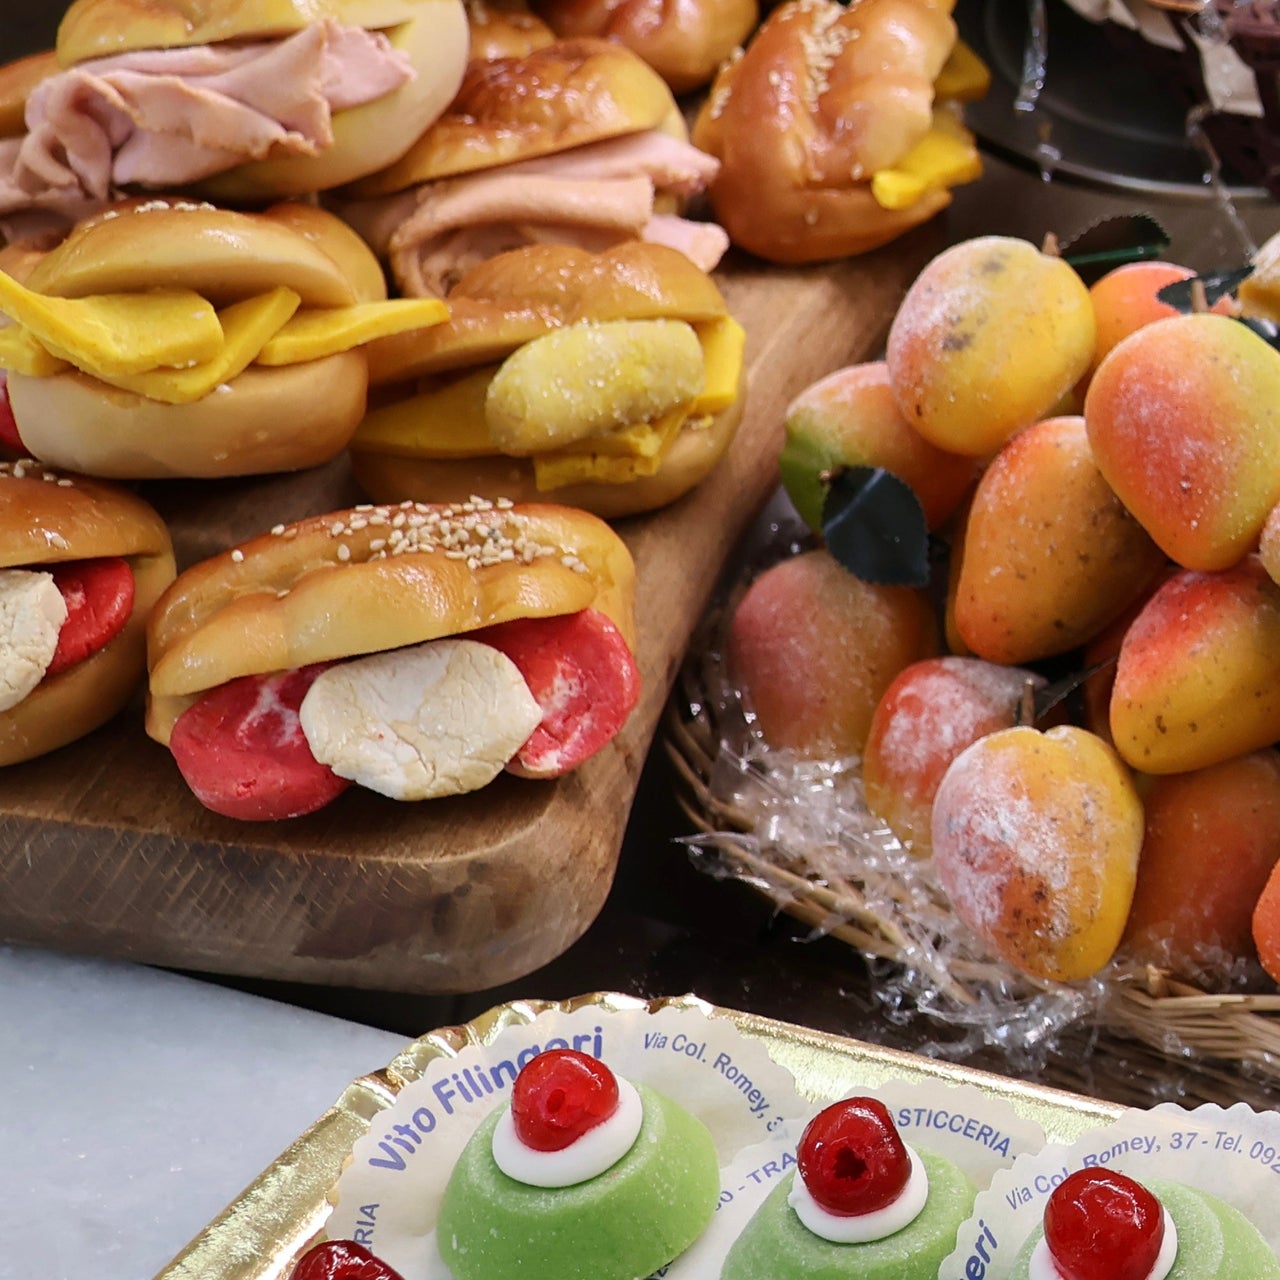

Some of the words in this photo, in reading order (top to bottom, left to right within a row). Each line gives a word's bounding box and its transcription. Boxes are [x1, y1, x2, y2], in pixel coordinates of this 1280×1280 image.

[644, 1032, 668, 1049] Via
[672, 1034, 706, 1063] Col.
[713, 1052, 770, 1118] Romey,
[368, 1107, 436, 1170] Vito
[897, 1108, 1011, 1158] STICCERIA
[746, 1152, 798, 1184] TRA
[1006, 1187, 1034, 1210] Via
[1034, 1167, 1070, 1193] Col
[1082, 1134, 1161, 1169] Romey,
[1169, 1132, 1197, 1150] 37
[1214, 1131, 1242, 1153] Tel.
[354, 1204, 380, 1246] RIA
[965, 1219, 998, 1280] eri
